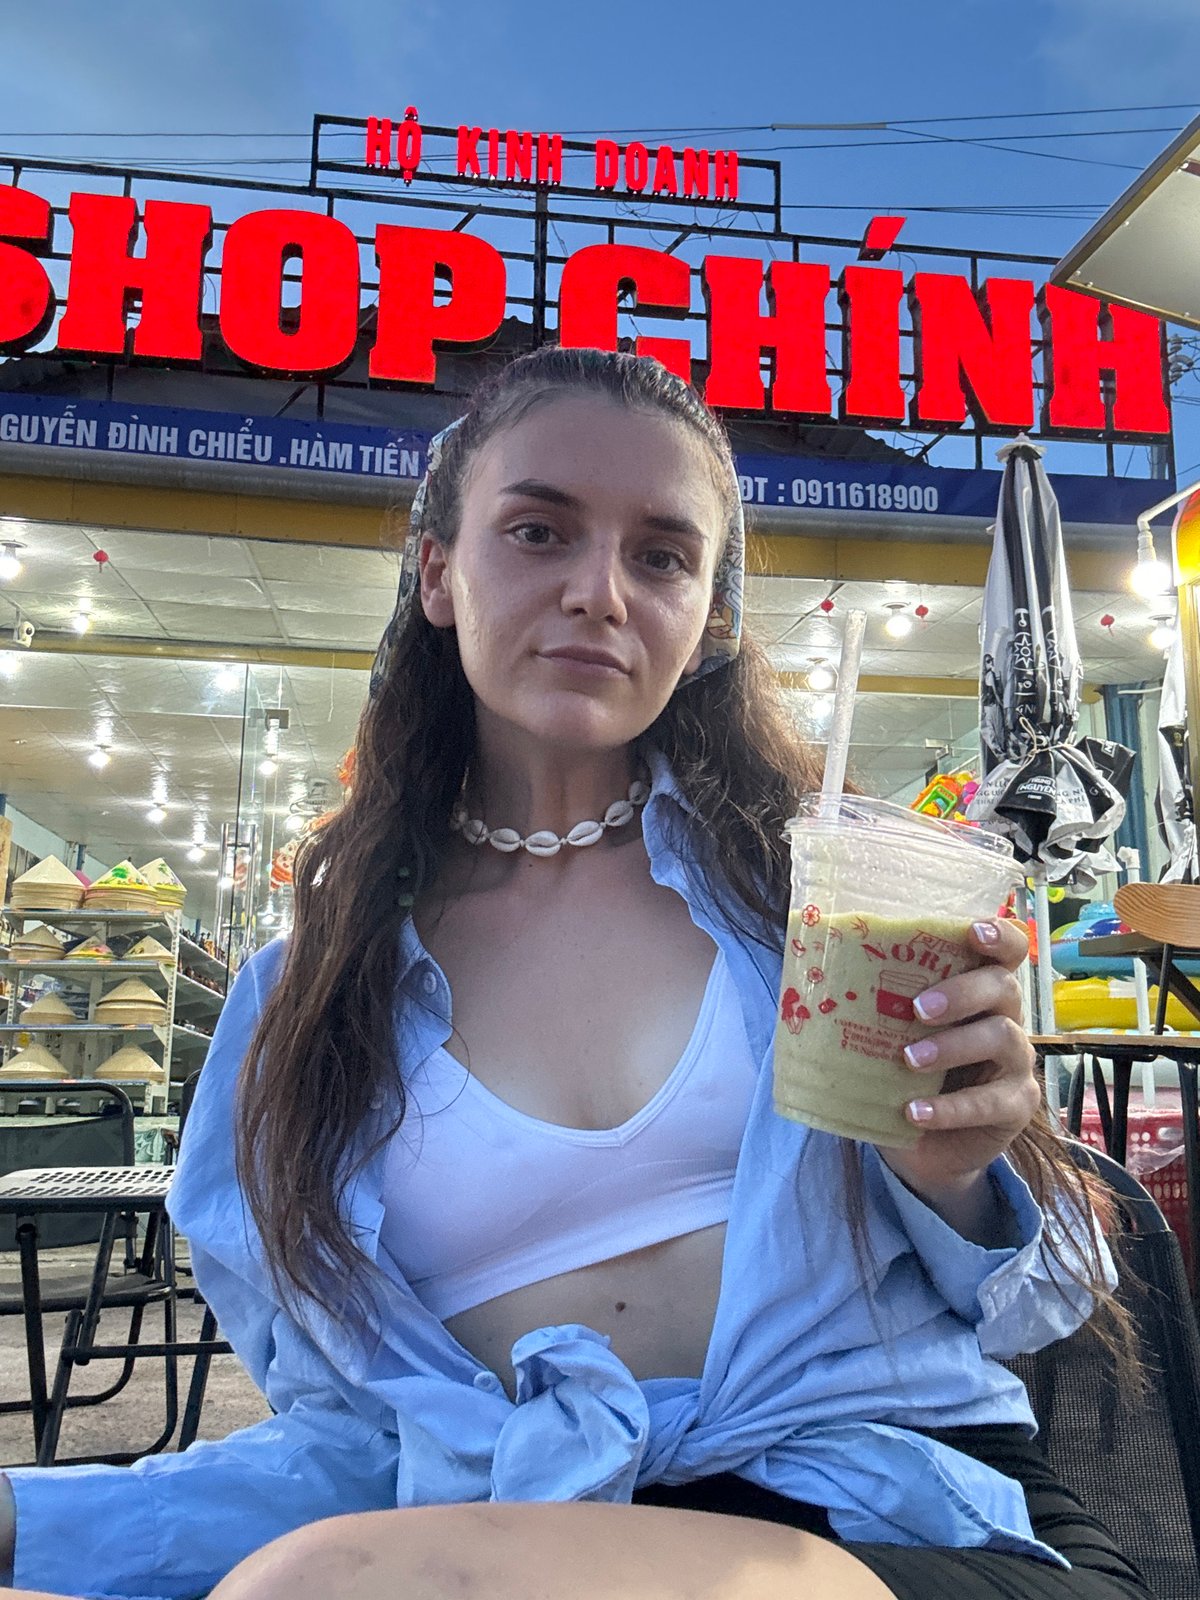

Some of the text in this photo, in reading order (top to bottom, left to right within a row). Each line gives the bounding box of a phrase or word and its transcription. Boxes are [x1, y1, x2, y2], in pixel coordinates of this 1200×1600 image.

[366, 105, 739, 200] HỘ KINH DOANH
[559, 217, 1171, 434] CHÍNH
[107, 414, 179, 454] ĐÌNH
[188, 418, 273, 462] CHIỂU
[359, 437, 420, 477] TIẾN
[791, 478, 939, 513] 0911618900
